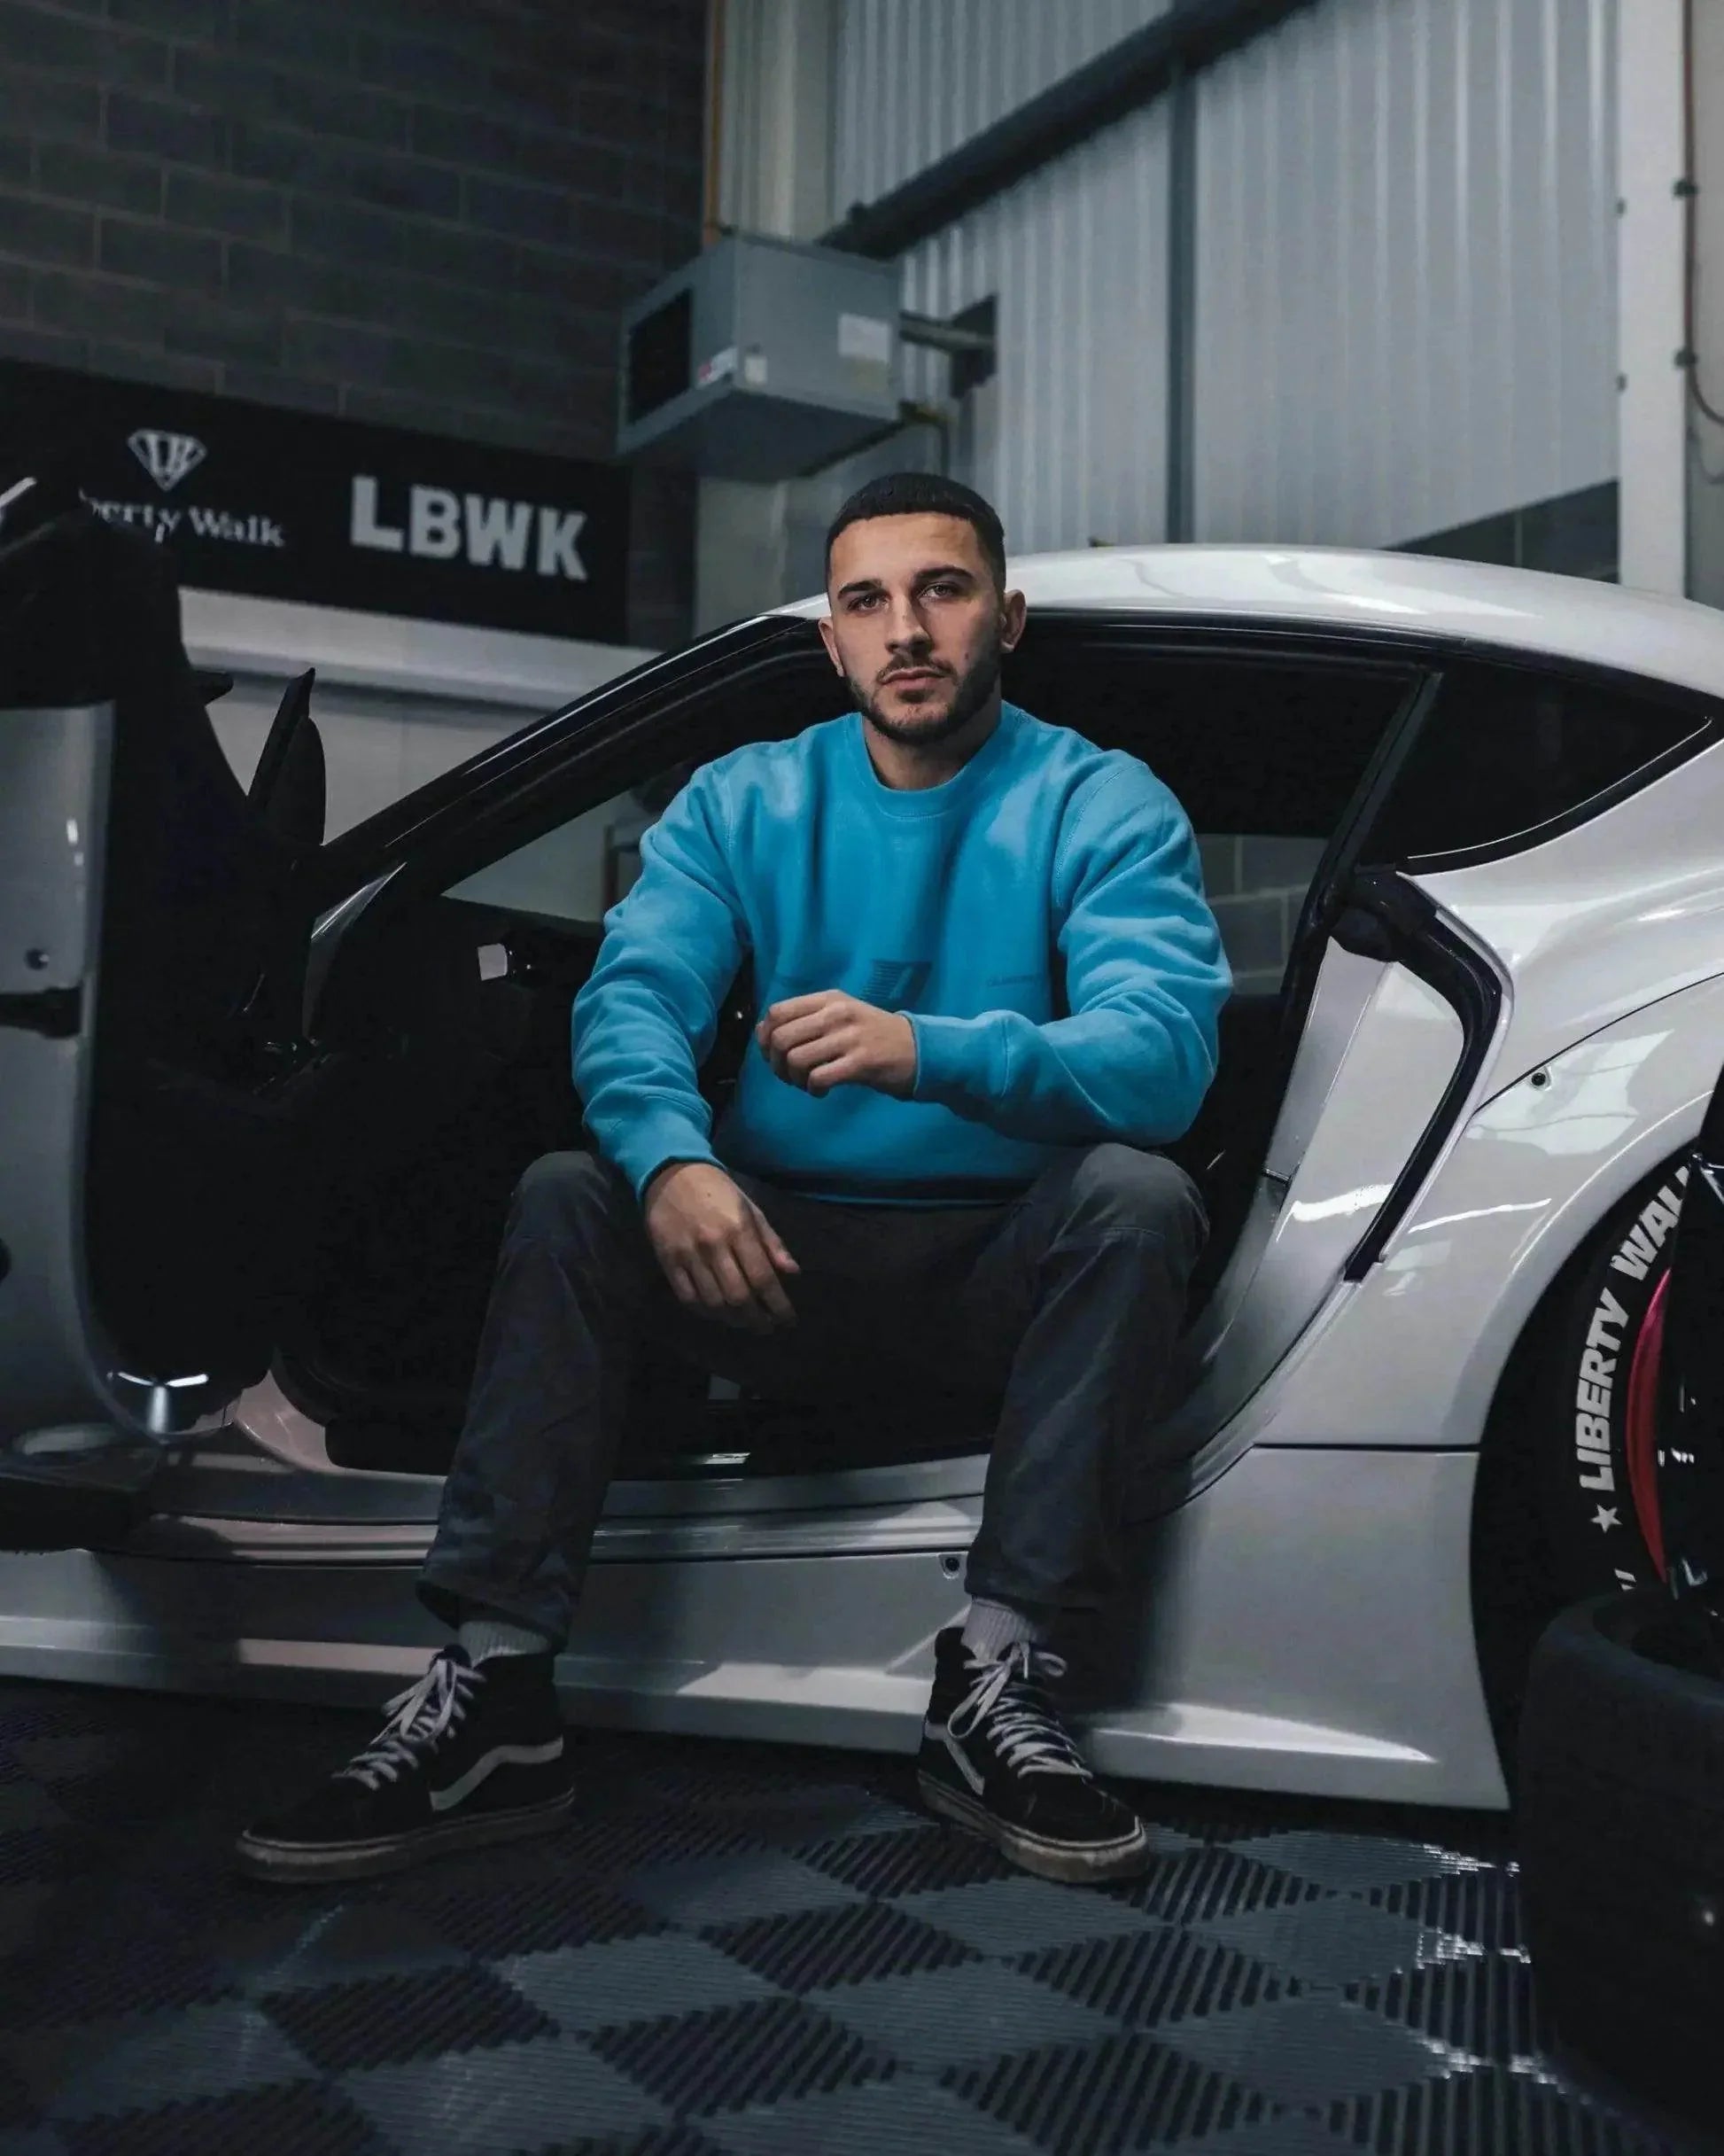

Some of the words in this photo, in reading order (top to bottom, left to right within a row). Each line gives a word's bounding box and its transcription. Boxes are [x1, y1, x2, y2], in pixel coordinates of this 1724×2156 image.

[189, 506, 285, 548] Walk
[351, 476, 586, 580] LBWK
[1575, 1287, 1630, 1492] LIBERTY
